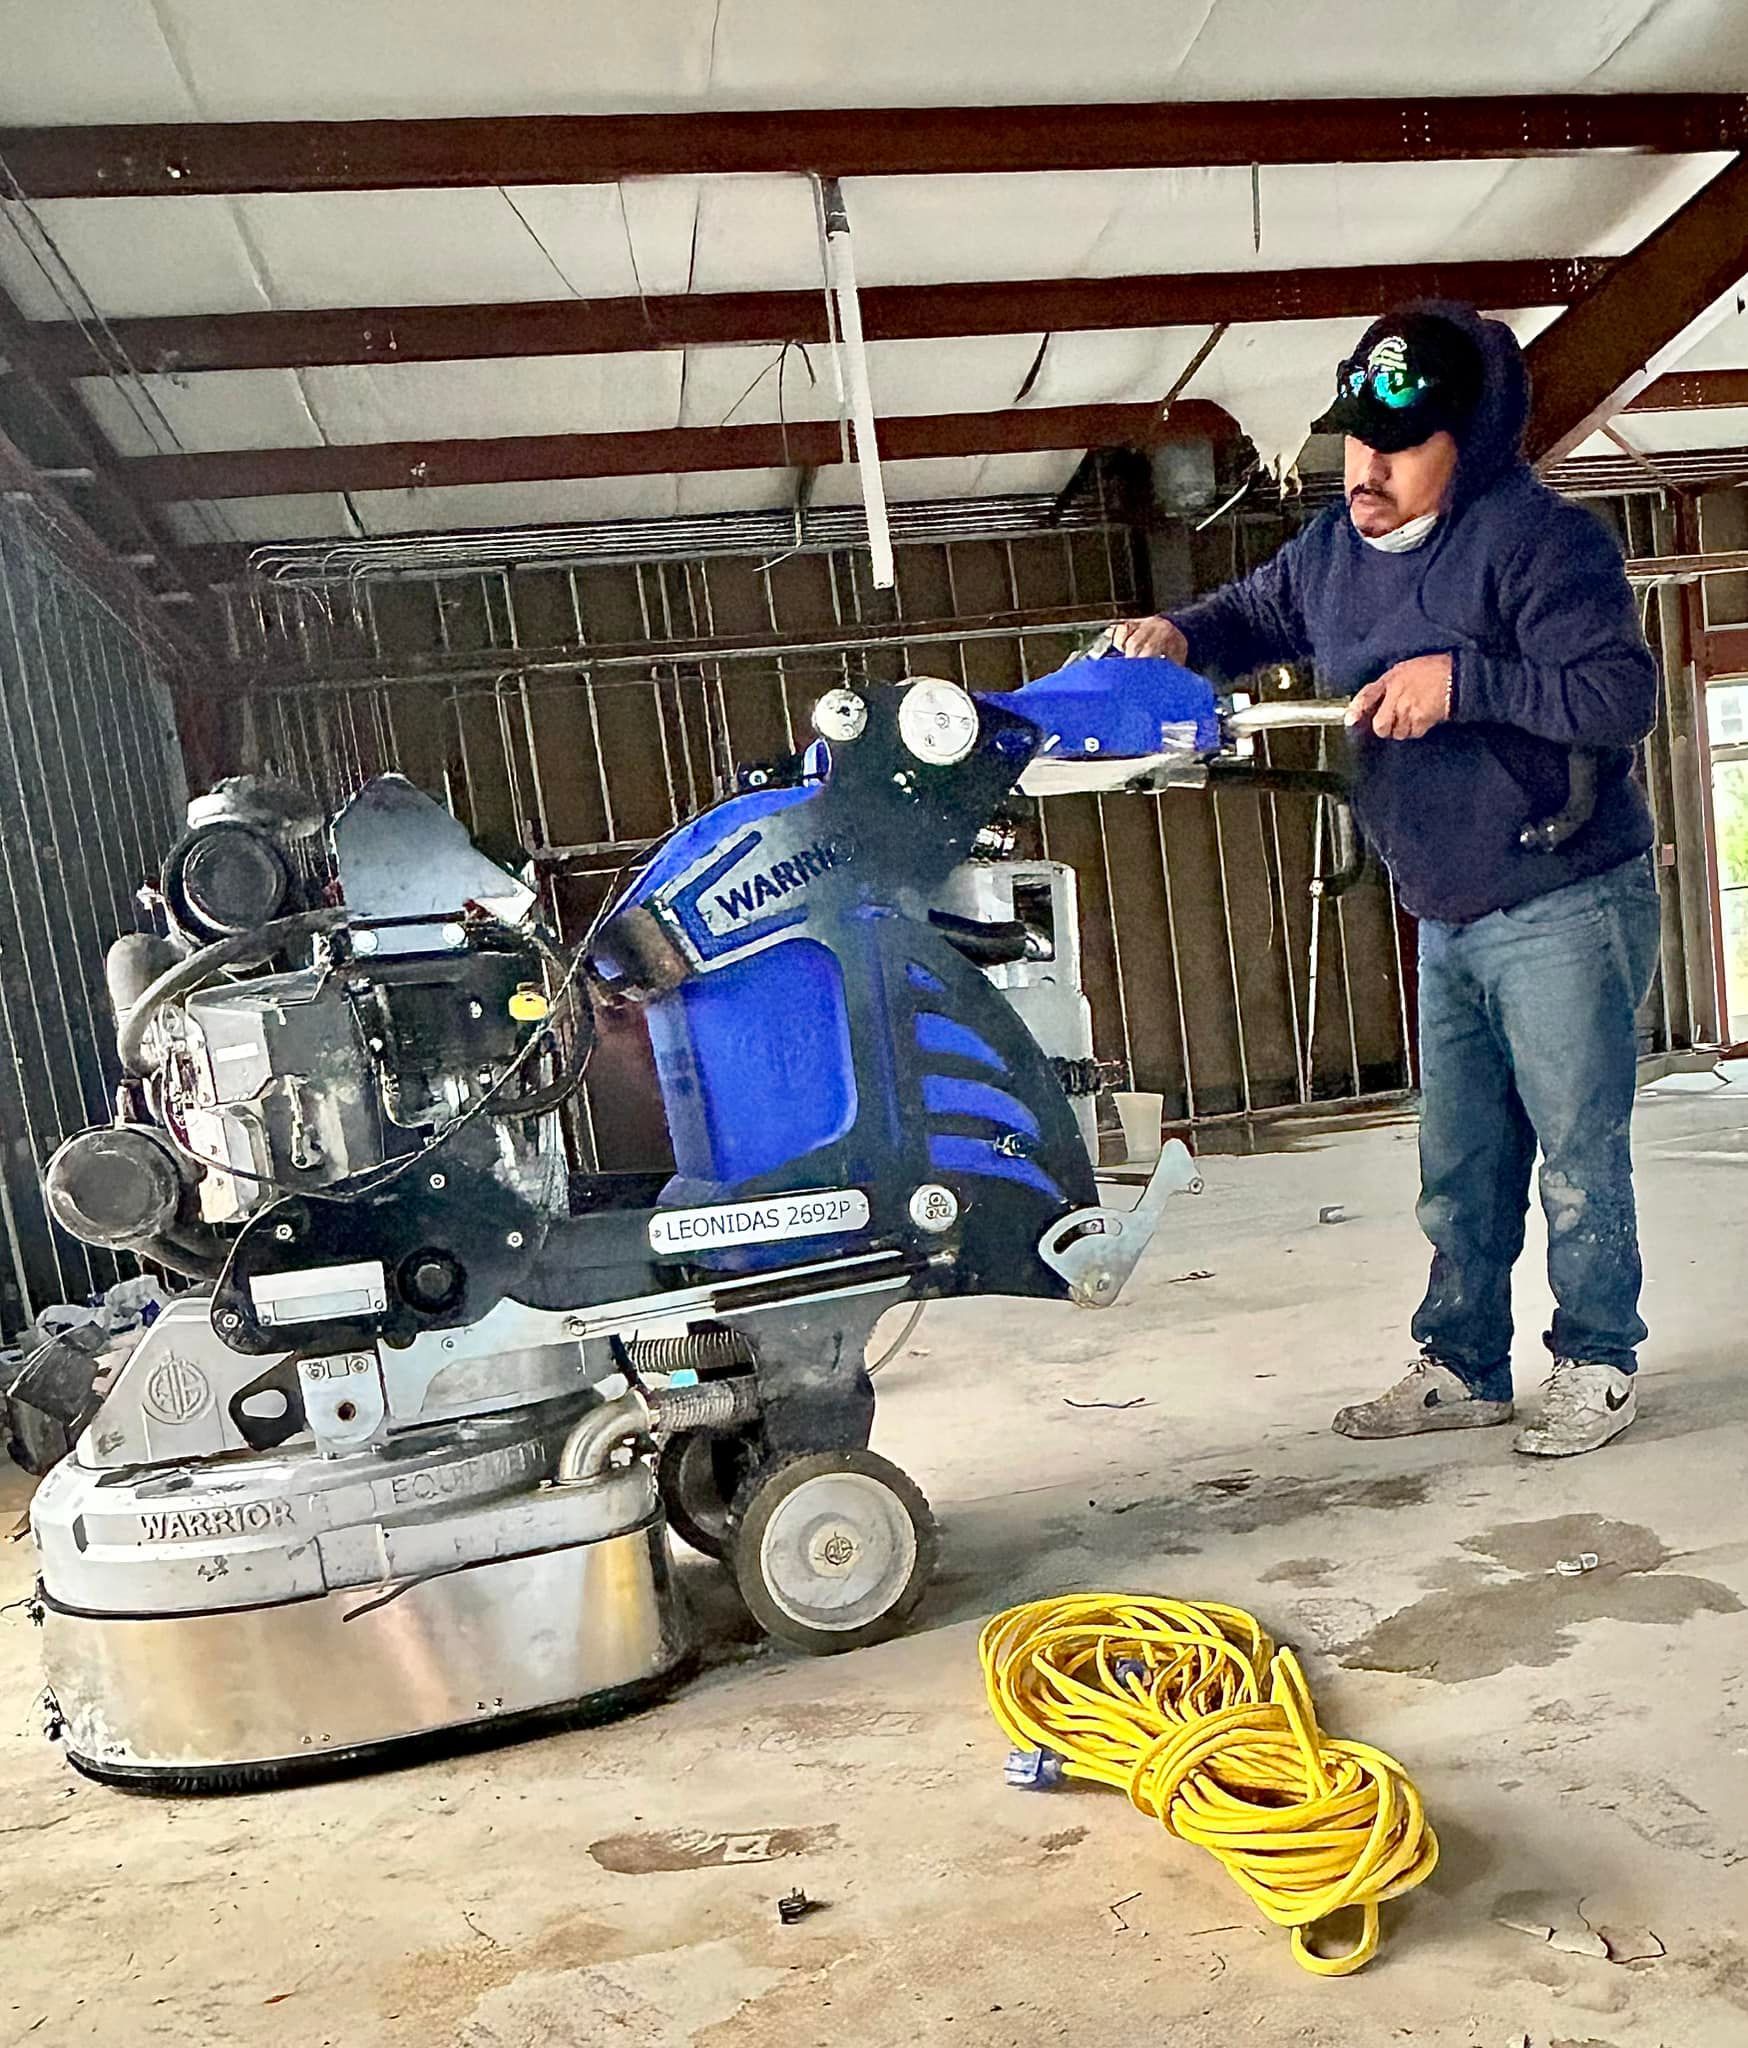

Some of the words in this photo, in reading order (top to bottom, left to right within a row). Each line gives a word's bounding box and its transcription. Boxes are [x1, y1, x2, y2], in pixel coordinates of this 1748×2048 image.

[666, 1208, 780, 1242] LEONIDAS
[787, 1200, 852, 1227] 2692P
[138, 1501, 296, 1540] WARRIOR
